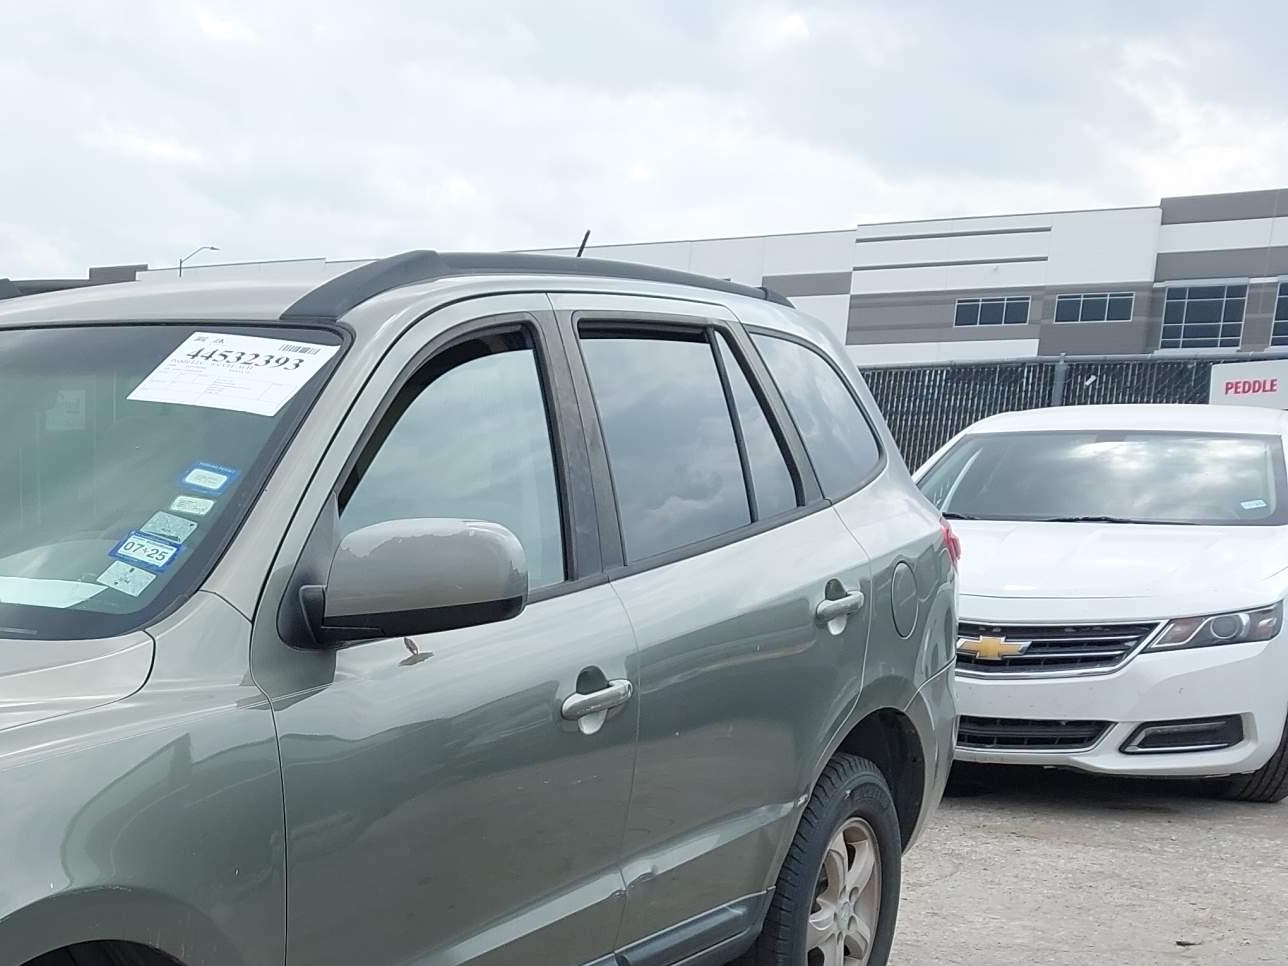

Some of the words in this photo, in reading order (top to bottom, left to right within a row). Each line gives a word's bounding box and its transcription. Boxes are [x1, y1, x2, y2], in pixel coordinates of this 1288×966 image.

[187, 346, 306, 371] 44532393
[1224, 379, 1278, 395] PEDDLE
[123, 541, 145, 554] 07
[147, 548, 169, 562] 25
